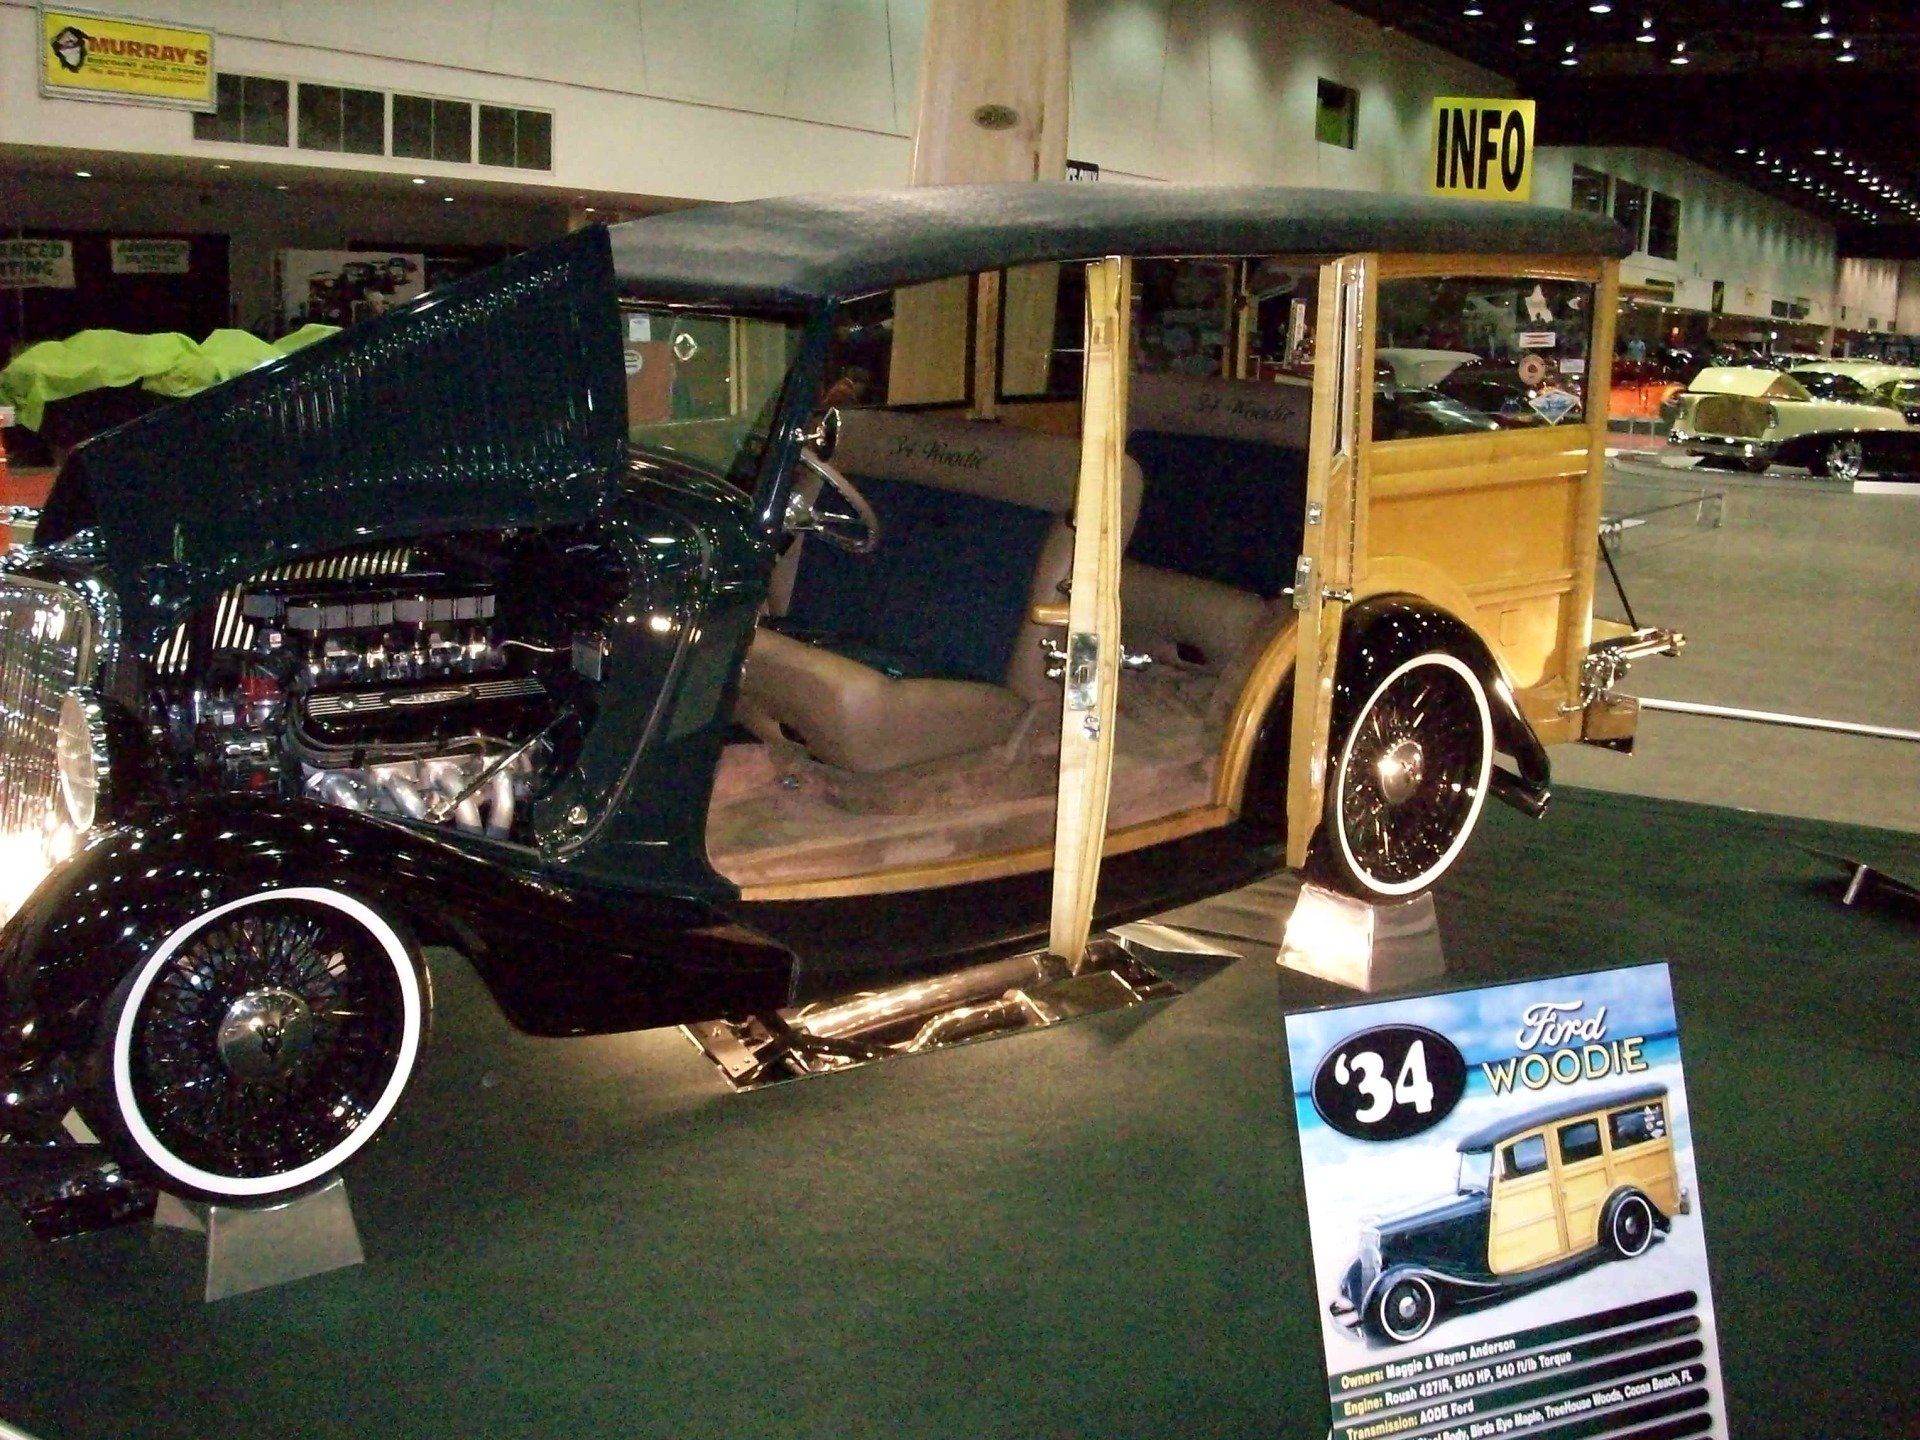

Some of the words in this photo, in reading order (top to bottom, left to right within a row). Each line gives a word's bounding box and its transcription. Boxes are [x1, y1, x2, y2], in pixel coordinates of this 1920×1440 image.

[87, 36, 208, 66] MURRAY'S
[1436, 108, 1525, 192] INFO
[1515, 1000, 1606, 1050] Ford
[1482, 1036, 1649, 1097] WOODIE
[1341, 1370, 1384, 1390] Owners:
[1386, 1359, 1423, 1379] Maggie
[1425, 1356, 1433, 1370] &
[1434, 1350, 1467, 1368] Wayne
[1469, 1338, 1516, 1359] Anderson
[1344, 1397, 1382, 1417] Engine:
[1385, 1386, 1417, 1405] Roush
[1476, 1369, 1494, 1383] HP,
[1496, 1363, 1515, 1379] 540
[1538, 1351, 1572, 1369] Torque
[1346, 1415, 1418, 1440] Transmission:
[1420, 1405, 1449, 1424] AODE
[1450, 1399, 1474, 1417] Ford
[1470, 1420, 1495, 1438] Birds
[1496, 1417, 1513, 1432] Eye
[1514, 1409, 1544, 1427] Maple,
[1544, 1398, 1592, 1419] TreeHouse
[1592, 1389, 1624, 1406] Woods,
[1624, 1381, 1651, 1399] Cocoa
[1652, 1373, 1681, 1391] Beach,
[1681, 1369, 1693, 1383] FL
